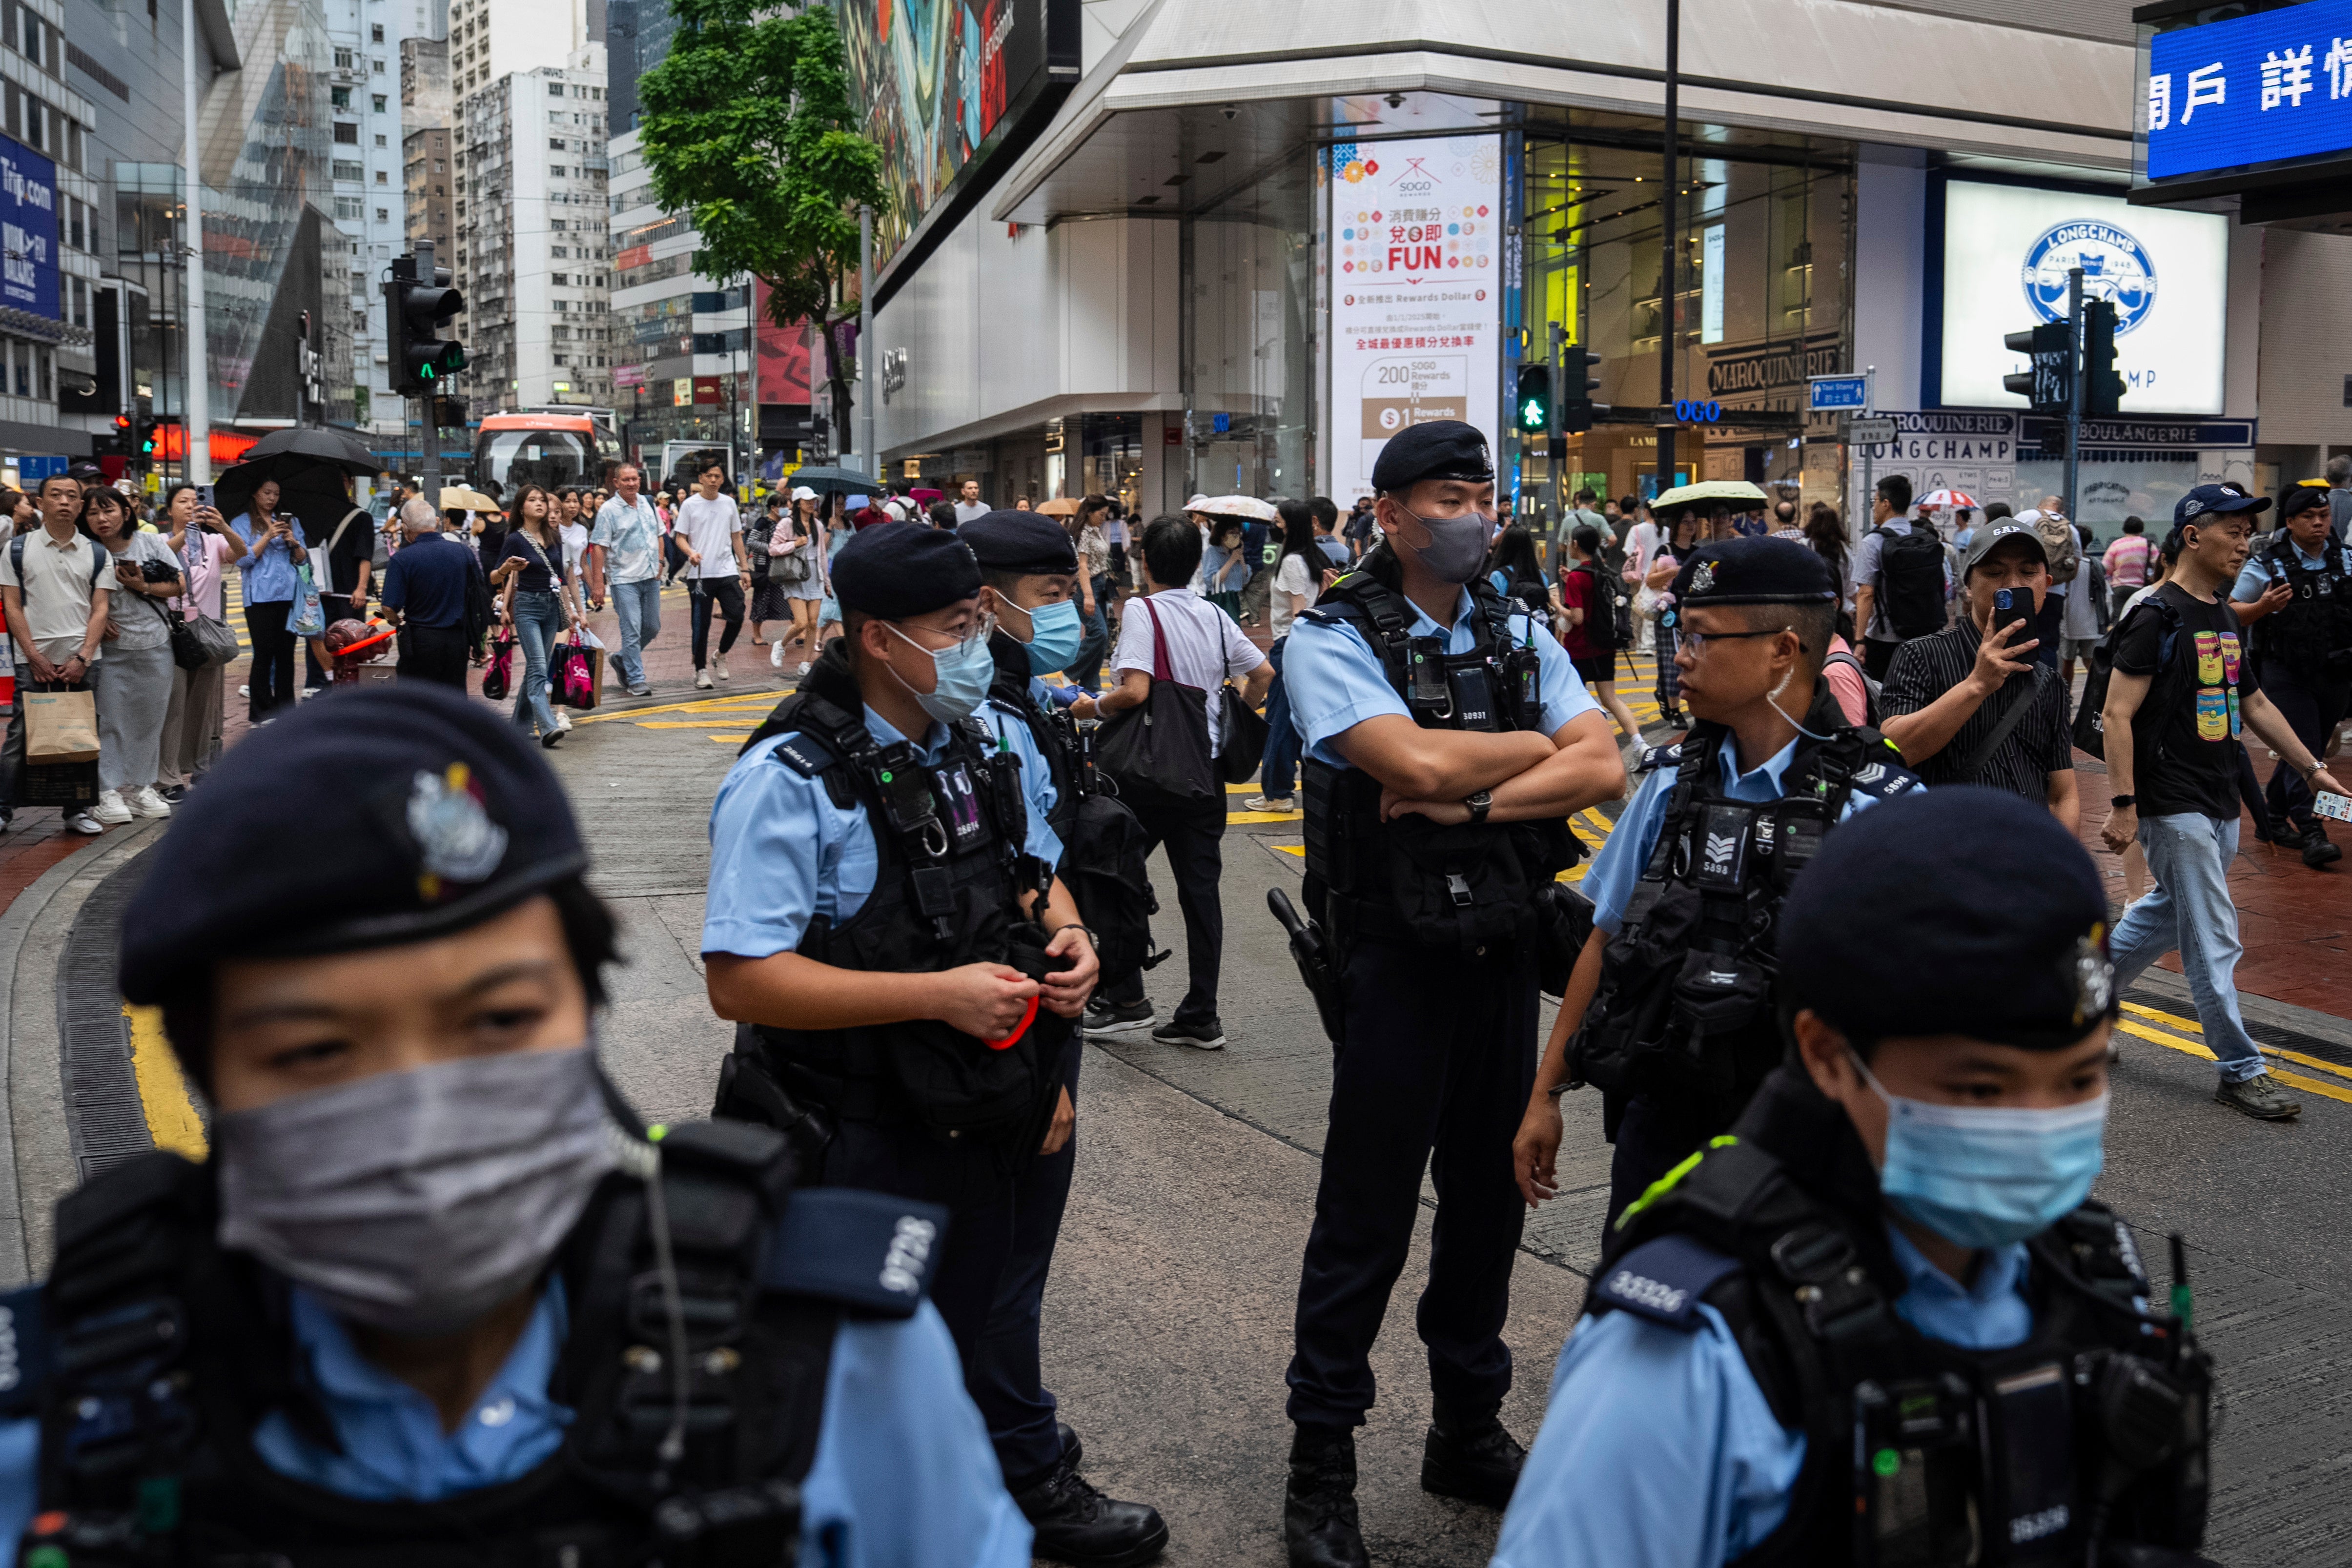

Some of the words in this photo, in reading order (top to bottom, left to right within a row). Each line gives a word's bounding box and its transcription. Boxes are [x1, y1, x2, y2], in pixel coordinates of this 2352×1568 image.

[0, 155, 51, 210] Trip.com
[1400, 181, 1431, 191] SOGO
[2047, 225, 2135, 253] LONGCHAMP
[1388, 245, 1441, 271] FUN
[2049, 255, 2076, 265] PARIS
[1396, 294, 1438, 303] Rewards
[1441, 292, 1472, 301] Dollar
[1378, 366, 1410, 384] 200
[1411, 361, 1436, 370] SOGO
[1411, 371, 1451, 381] Rewards
[1413, 407, 1455, 418] Rewards
[1673, 399, 1720, 422] OGO
[2078, 423, 2197, 441] BOULANGERIE
[1630, 437, 1643, 446] LA
[1993, 526, 2021, 536] GAP
[782, 745, 814, 768] 28614
[1883, 775, 1909, 795] 5898
[1704, 861, 1728, 876] 5898
